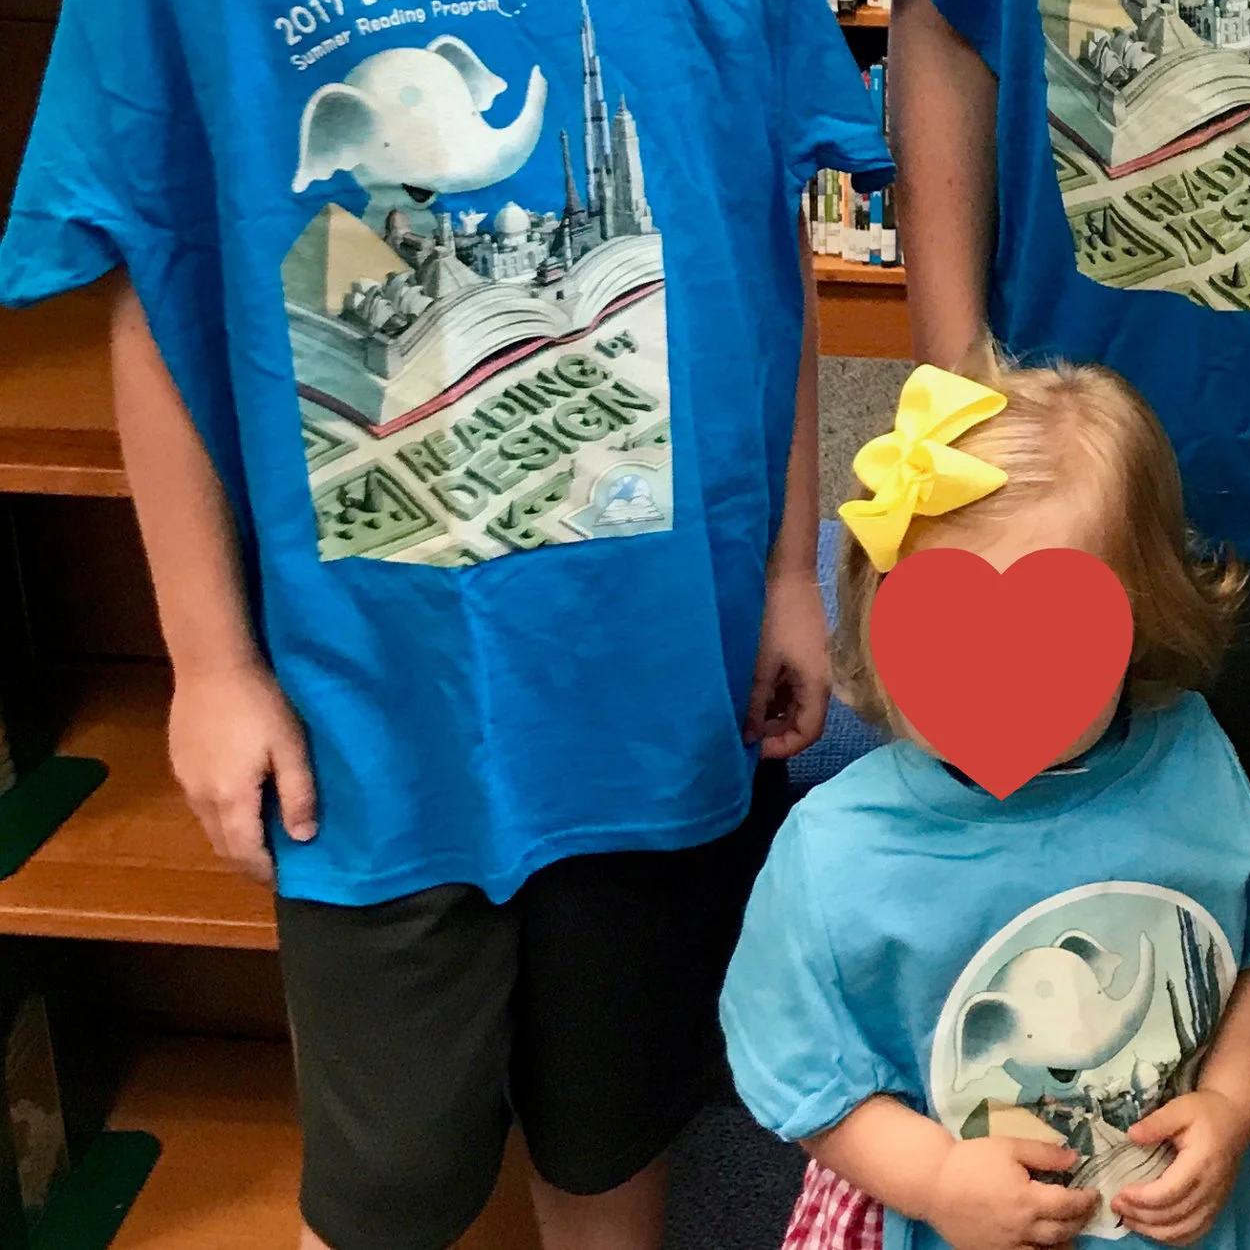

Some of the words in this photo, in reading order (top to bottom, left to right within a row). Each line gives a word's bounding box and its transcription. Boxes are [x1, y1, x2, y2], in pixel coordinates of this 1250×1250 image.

[289, 31, 351, 71] Summer
[356, 8, 426, 36] Reading
[394, 353, 613, 484] READING
[594, 329, 640, 358] by
[428, 377, 660, 522] DESIGN
